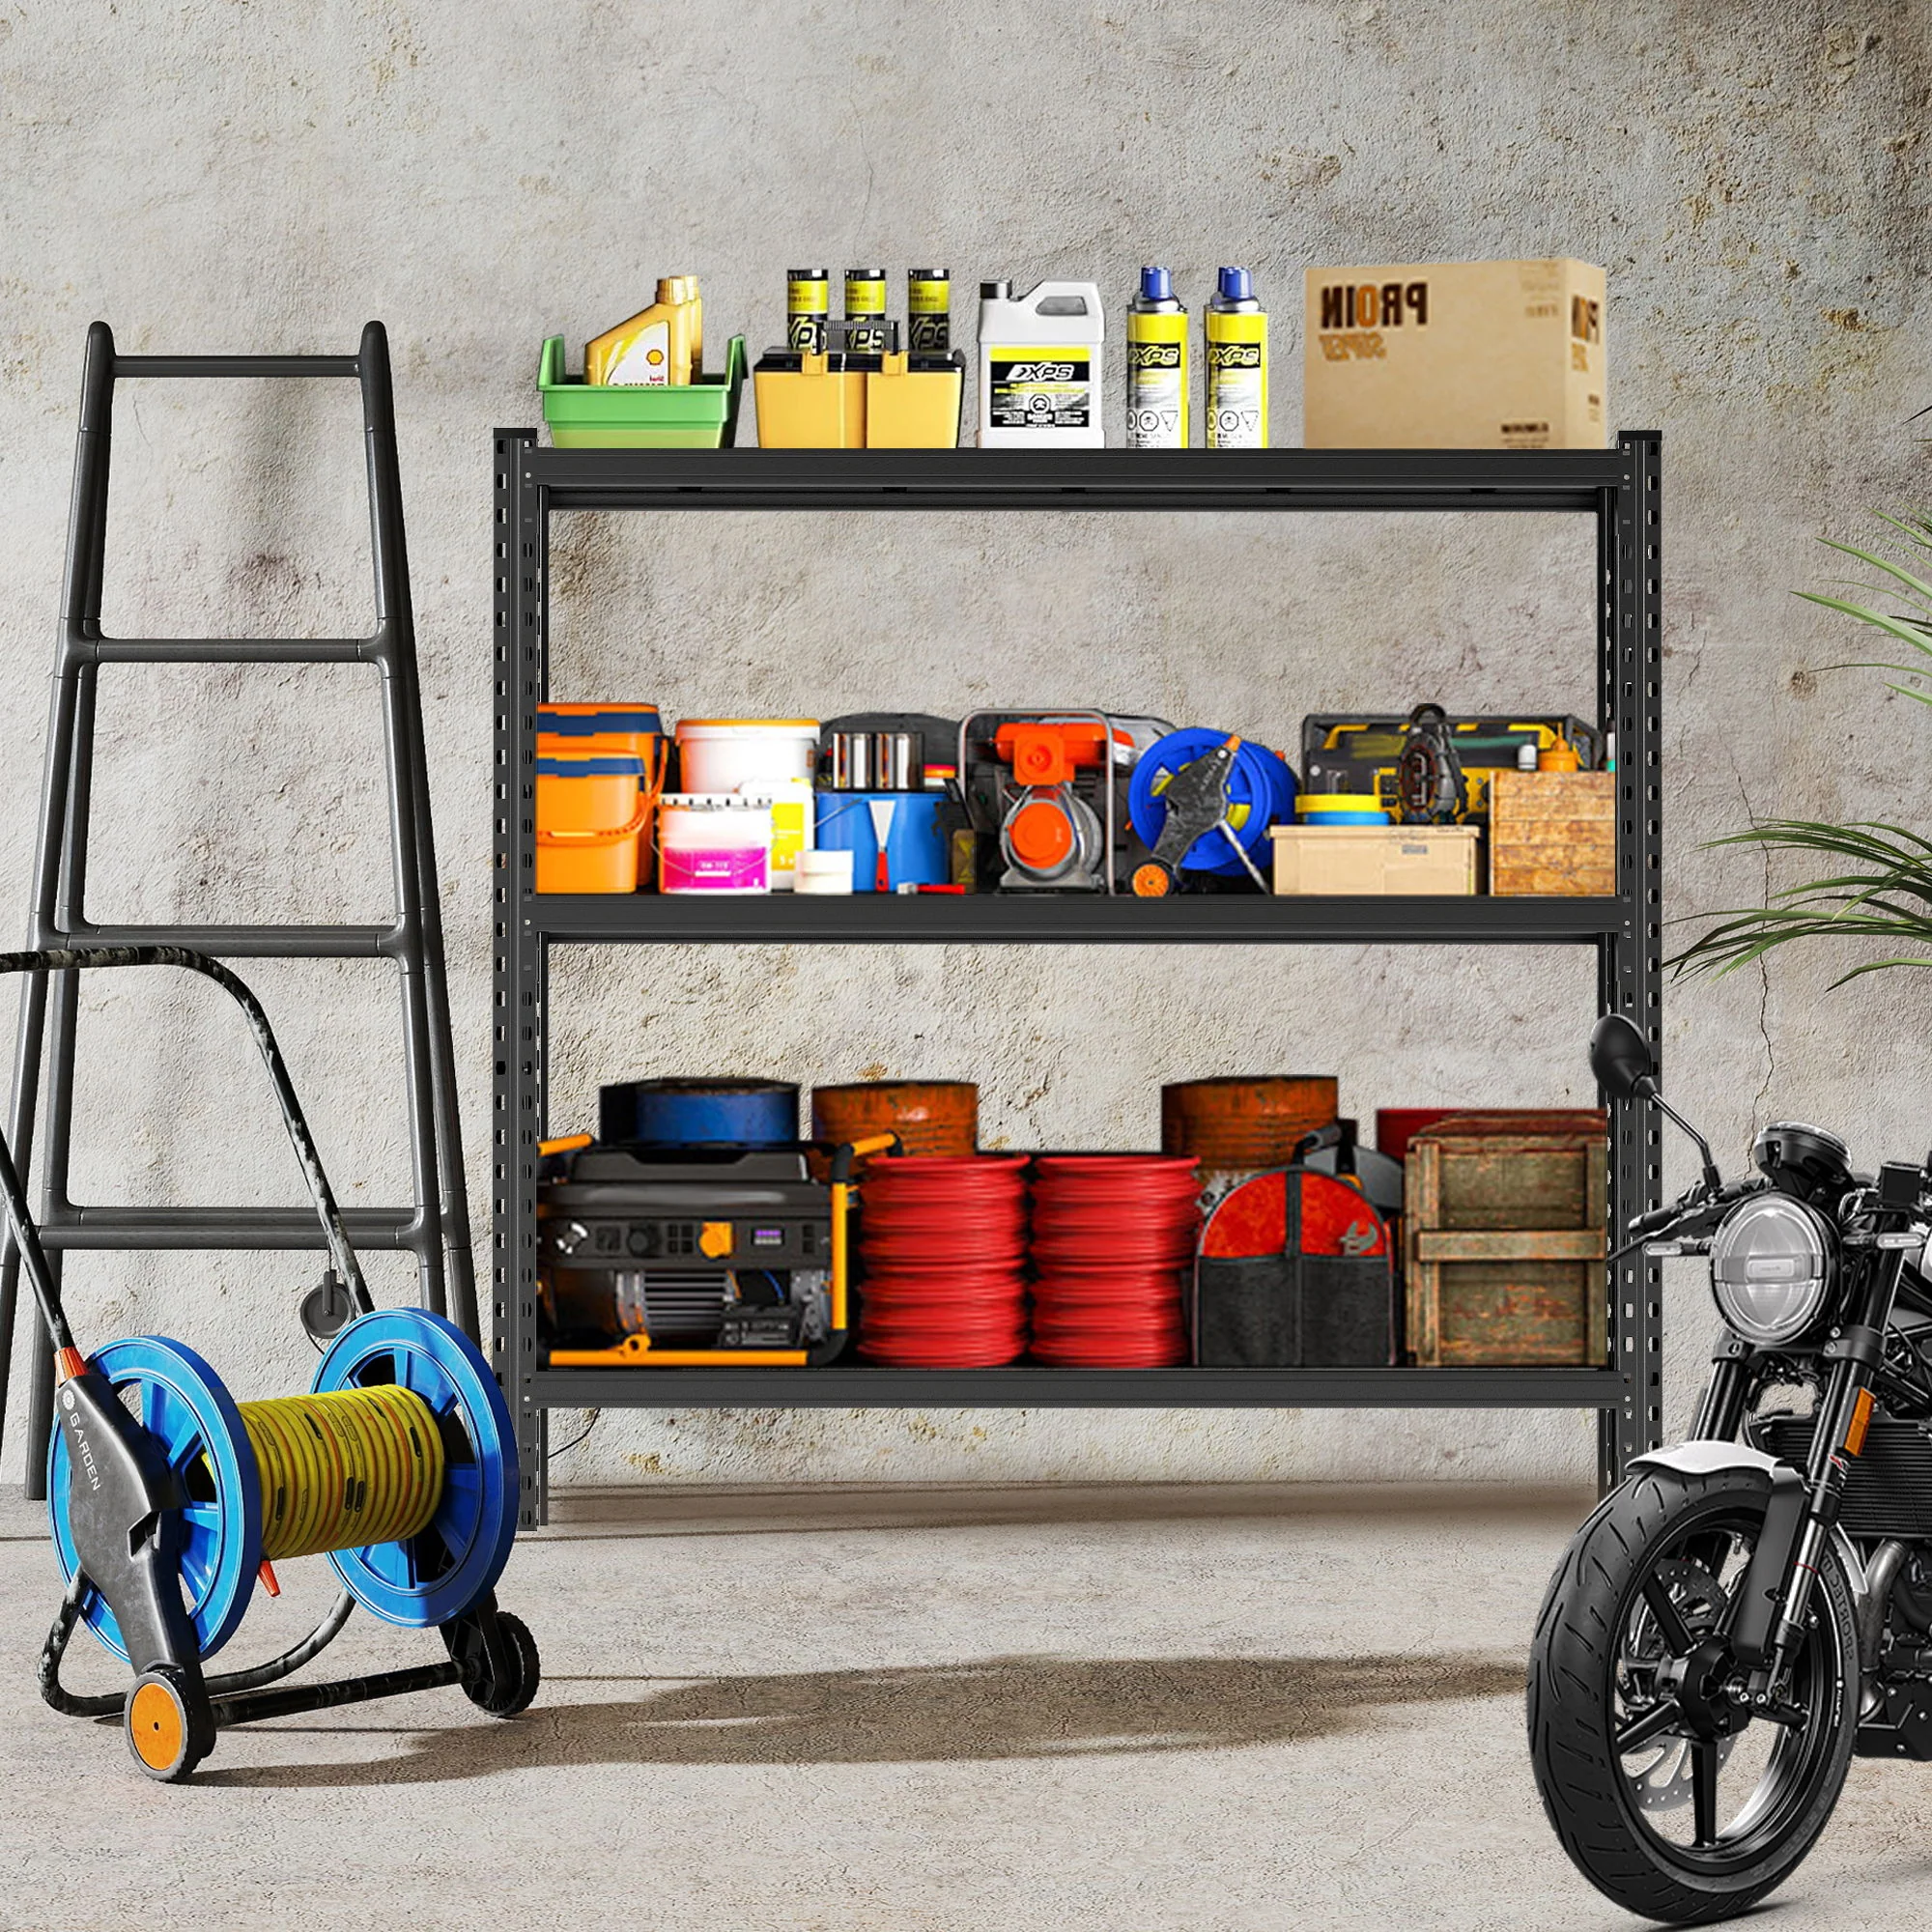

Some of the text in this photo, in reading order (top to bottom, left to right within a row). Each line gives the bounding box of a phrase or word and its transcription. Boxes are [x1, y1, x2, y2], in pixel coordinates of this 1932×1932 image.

[1133, 345, 1179, 366] XPS
[1213, 345, 1260, 366] XPS
[1022, 361, 1075, 382] XPS
[70, 1411, 101, 1492] GARDEN
